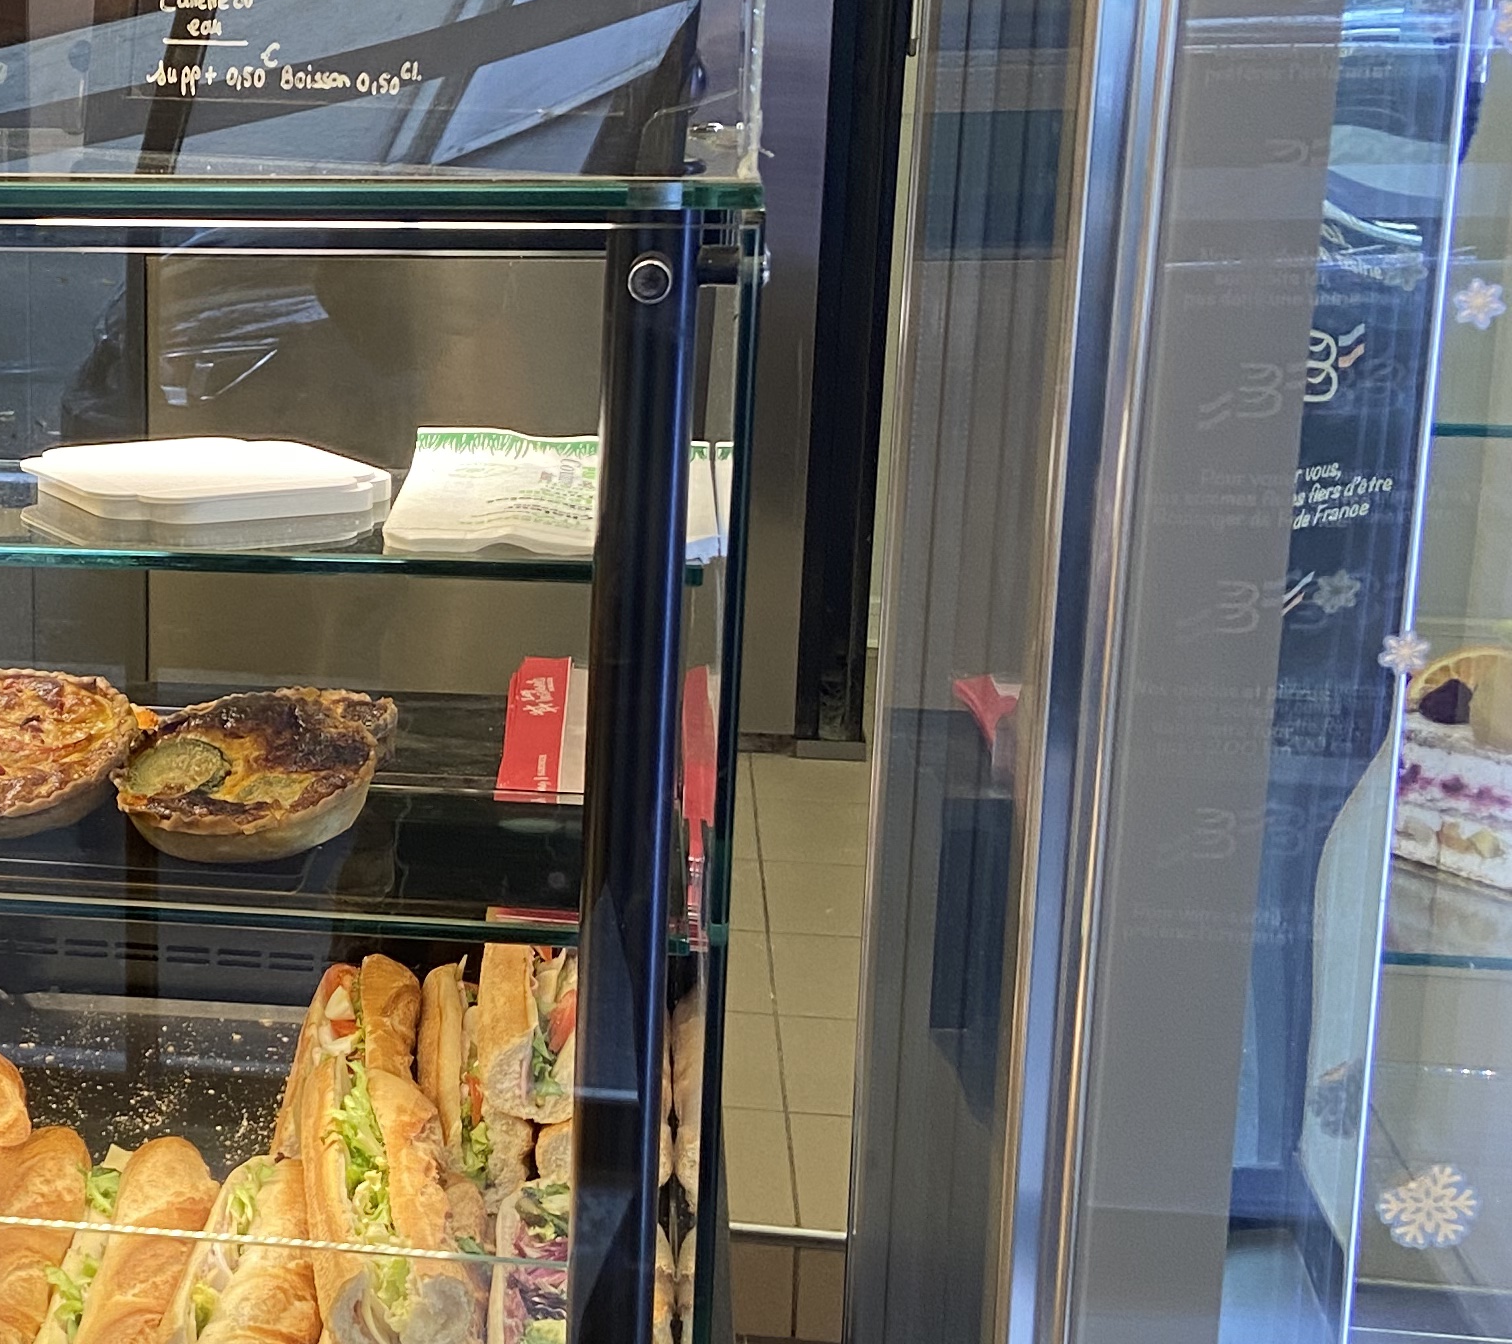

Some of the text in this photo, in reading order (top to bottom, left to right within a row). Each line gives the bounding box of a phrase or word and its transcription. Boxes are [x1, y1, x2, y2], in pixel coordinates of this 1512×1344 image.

[186, 17, 222, 36] eau
[280, 64, 351, 90] Boisson
[1293, 509, 1312, 530] de
[1312, 503, 1370, 527] France
